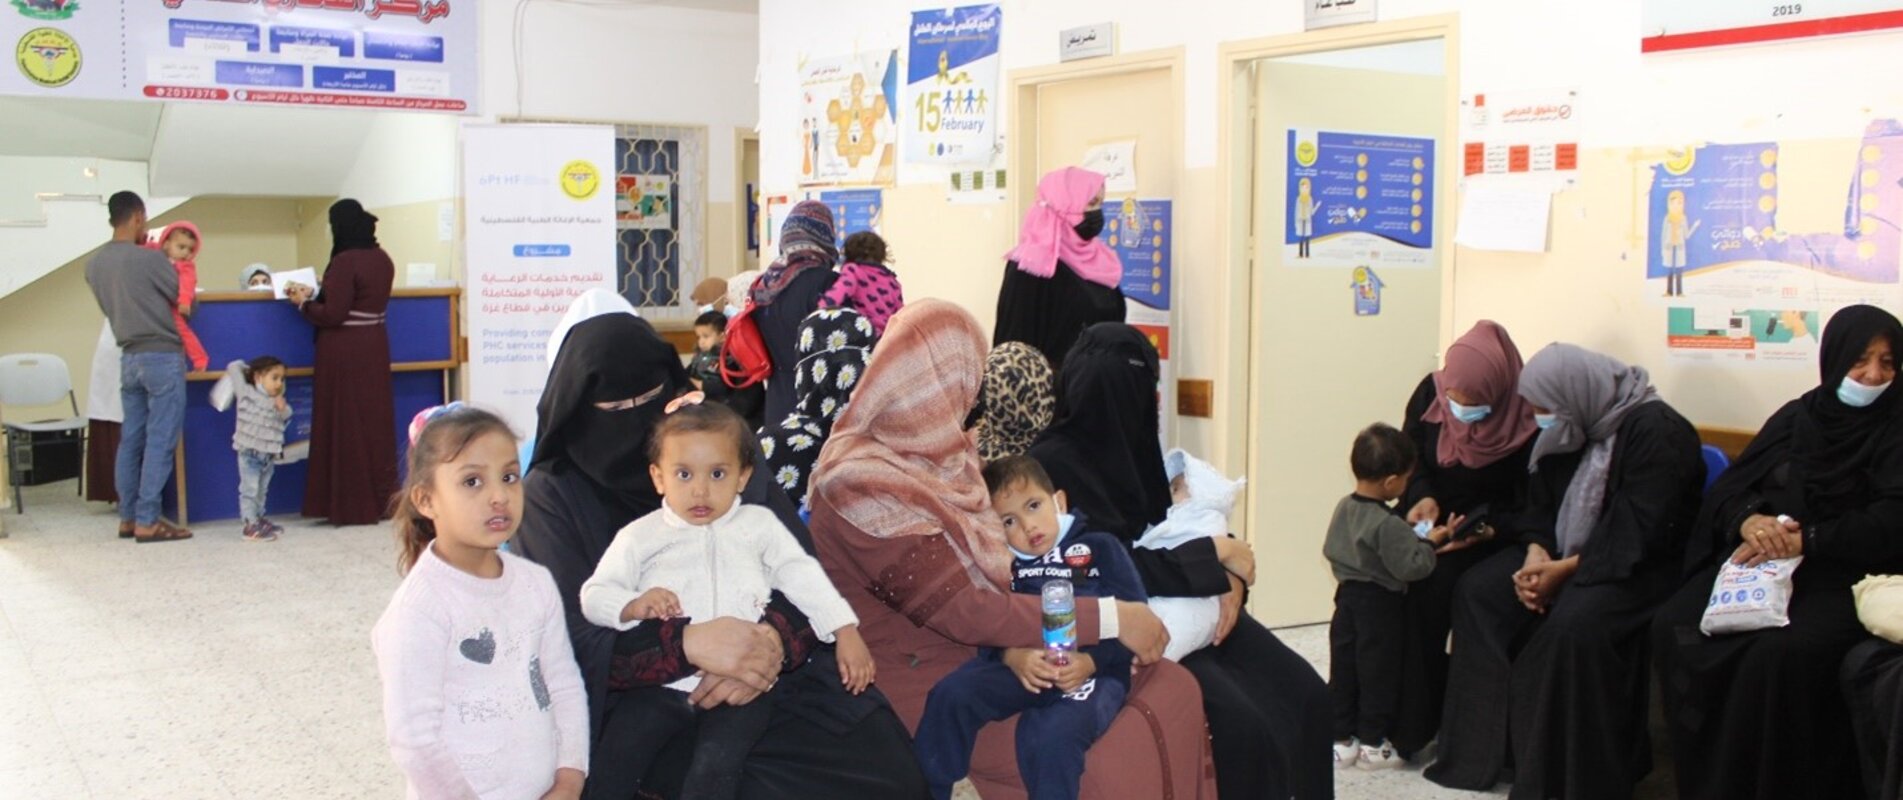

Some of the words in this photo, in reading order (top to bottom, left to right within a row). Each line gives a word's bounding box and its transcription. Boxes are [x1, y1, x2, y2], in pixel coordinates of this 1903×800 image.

[1772, 4, 1802, 17] 2019
[1067, 29, 1096, 48] تمريض
[166, 88, 217, 99] 2037376
[915, 91, 942, 132] 15
[941, 118, 985, 134] February
[529, 273, 568, 283] خدمات
[570, 273, 603, 284] تقديم
[482, 303, 499, 314] غزة
[482, 328, 528, 339] Providing
[482, 340, 503, 350] PHC
[506, 341, 547, 350] services
[482, 353, 534, 364] population
[1018, 567, 1044, 578] SPORT
